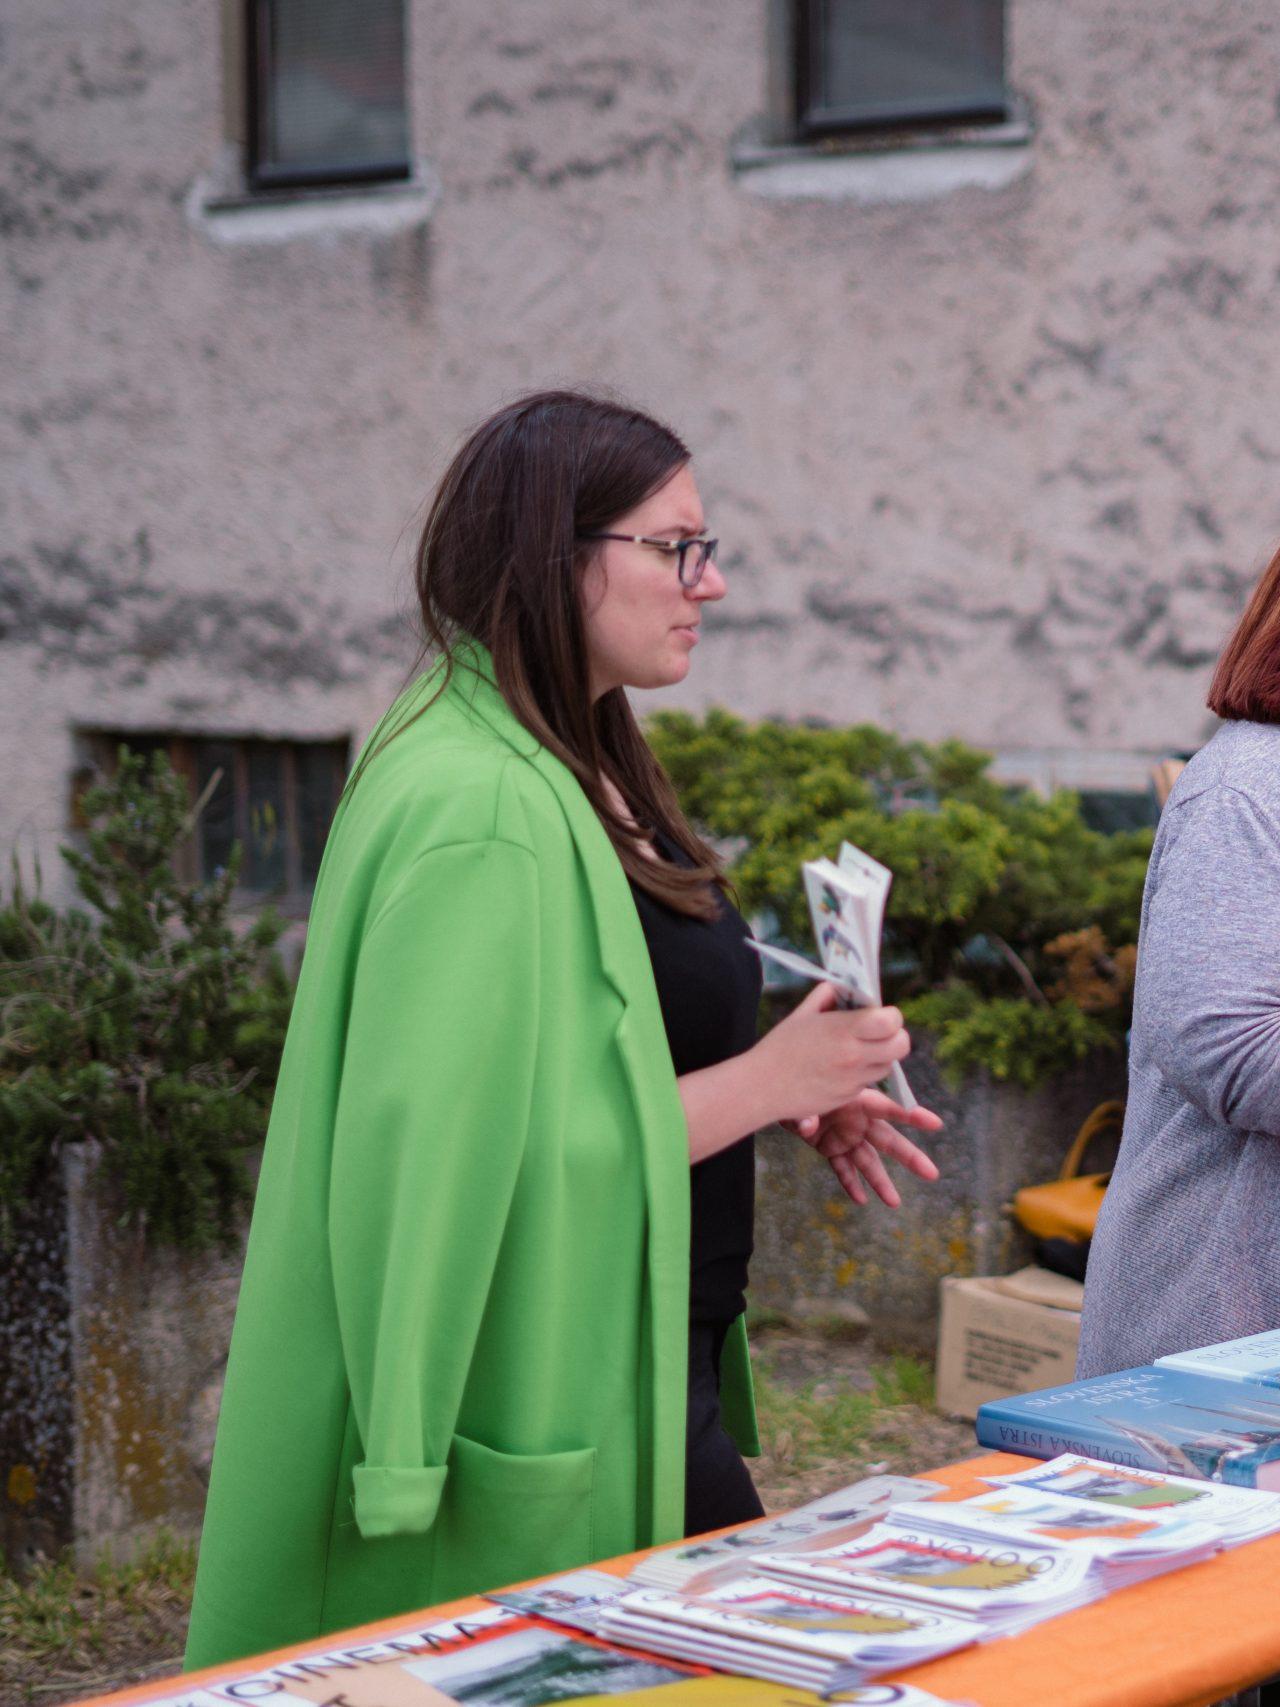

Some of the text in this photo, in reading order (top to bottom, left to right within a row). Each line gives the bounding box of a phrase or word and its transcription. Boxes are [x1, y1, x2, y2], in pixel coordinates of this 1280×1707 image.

[1024, 1373, 1164, 1408] SLOVENSKA
[1083, 1385, 1160, 1405] ISTRA
[1000, 1426, 1141, 1469] SLOVENSKA ISTRA
[225, 1619, 494, 1699] CINEMA
